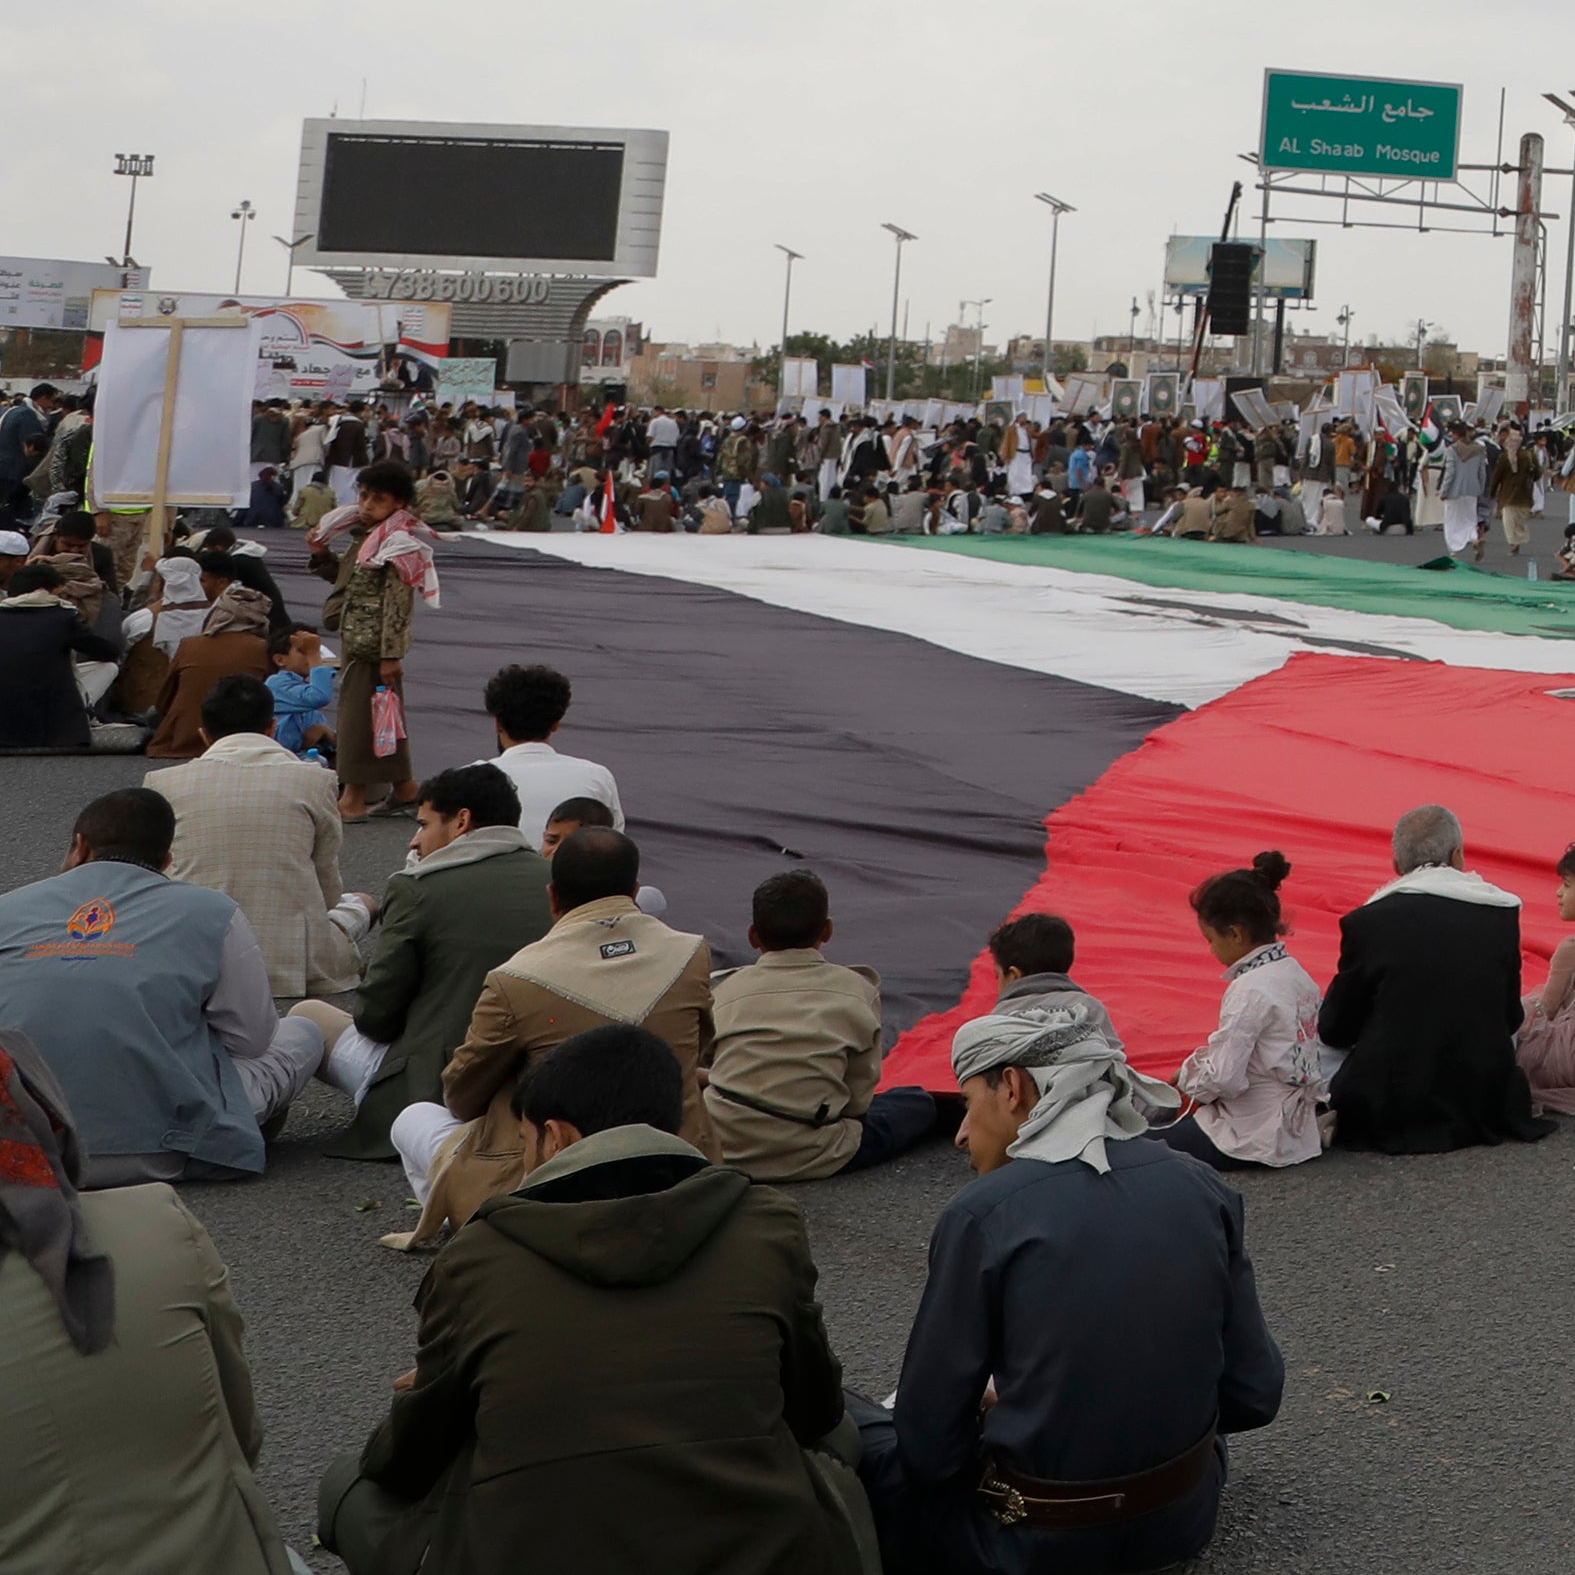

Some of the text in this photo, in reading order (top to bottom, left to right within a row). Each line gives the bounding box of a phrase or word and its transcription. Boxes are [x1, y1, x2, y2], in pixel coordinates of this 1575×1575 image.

[1290, 94, 1435, 123] جامع الشعب
[1278, 137, 1441, 164] AL Shaab Mosque
